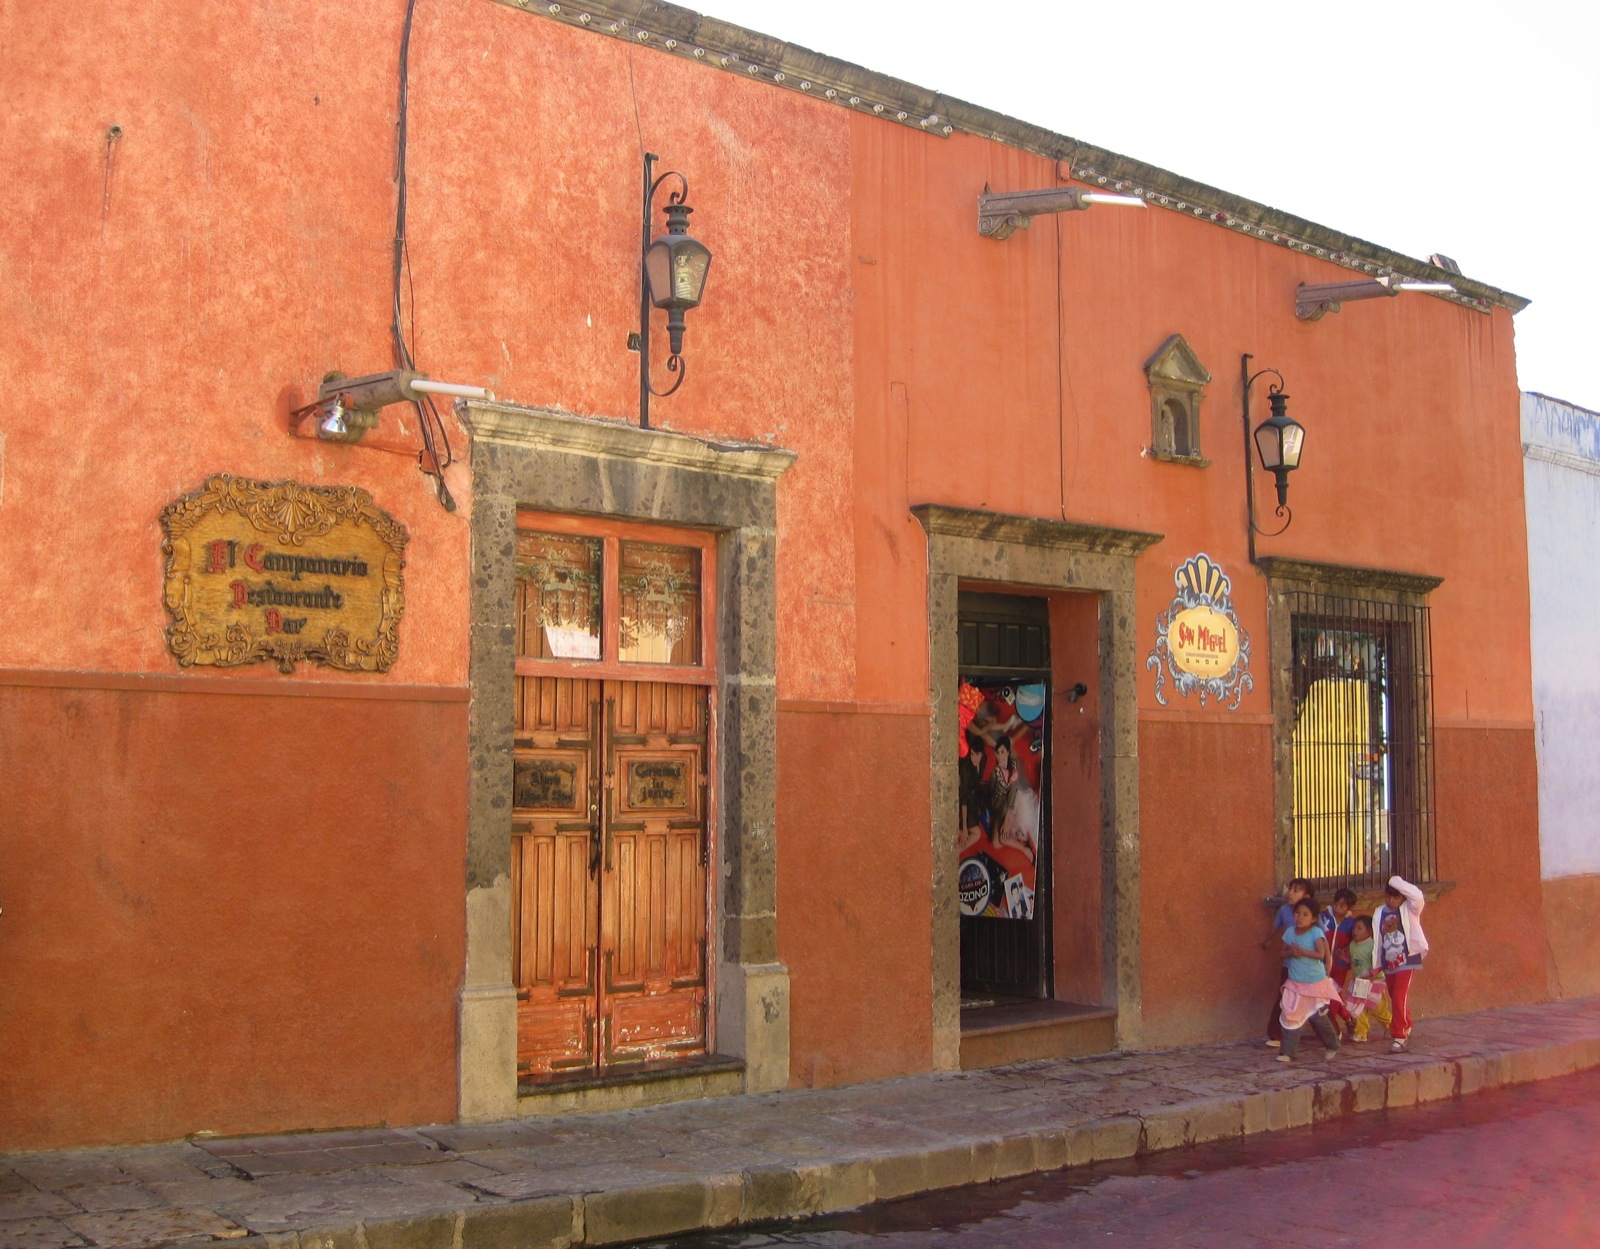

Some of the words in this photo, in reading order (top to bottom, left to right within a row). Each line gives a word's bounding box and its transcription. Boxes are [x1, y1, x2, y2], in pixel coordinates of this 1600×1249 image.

[207, 539, 238, 575] El
[244, 542, 368, 581] Campanario
[229, 579, 343, 609] Restaurante
